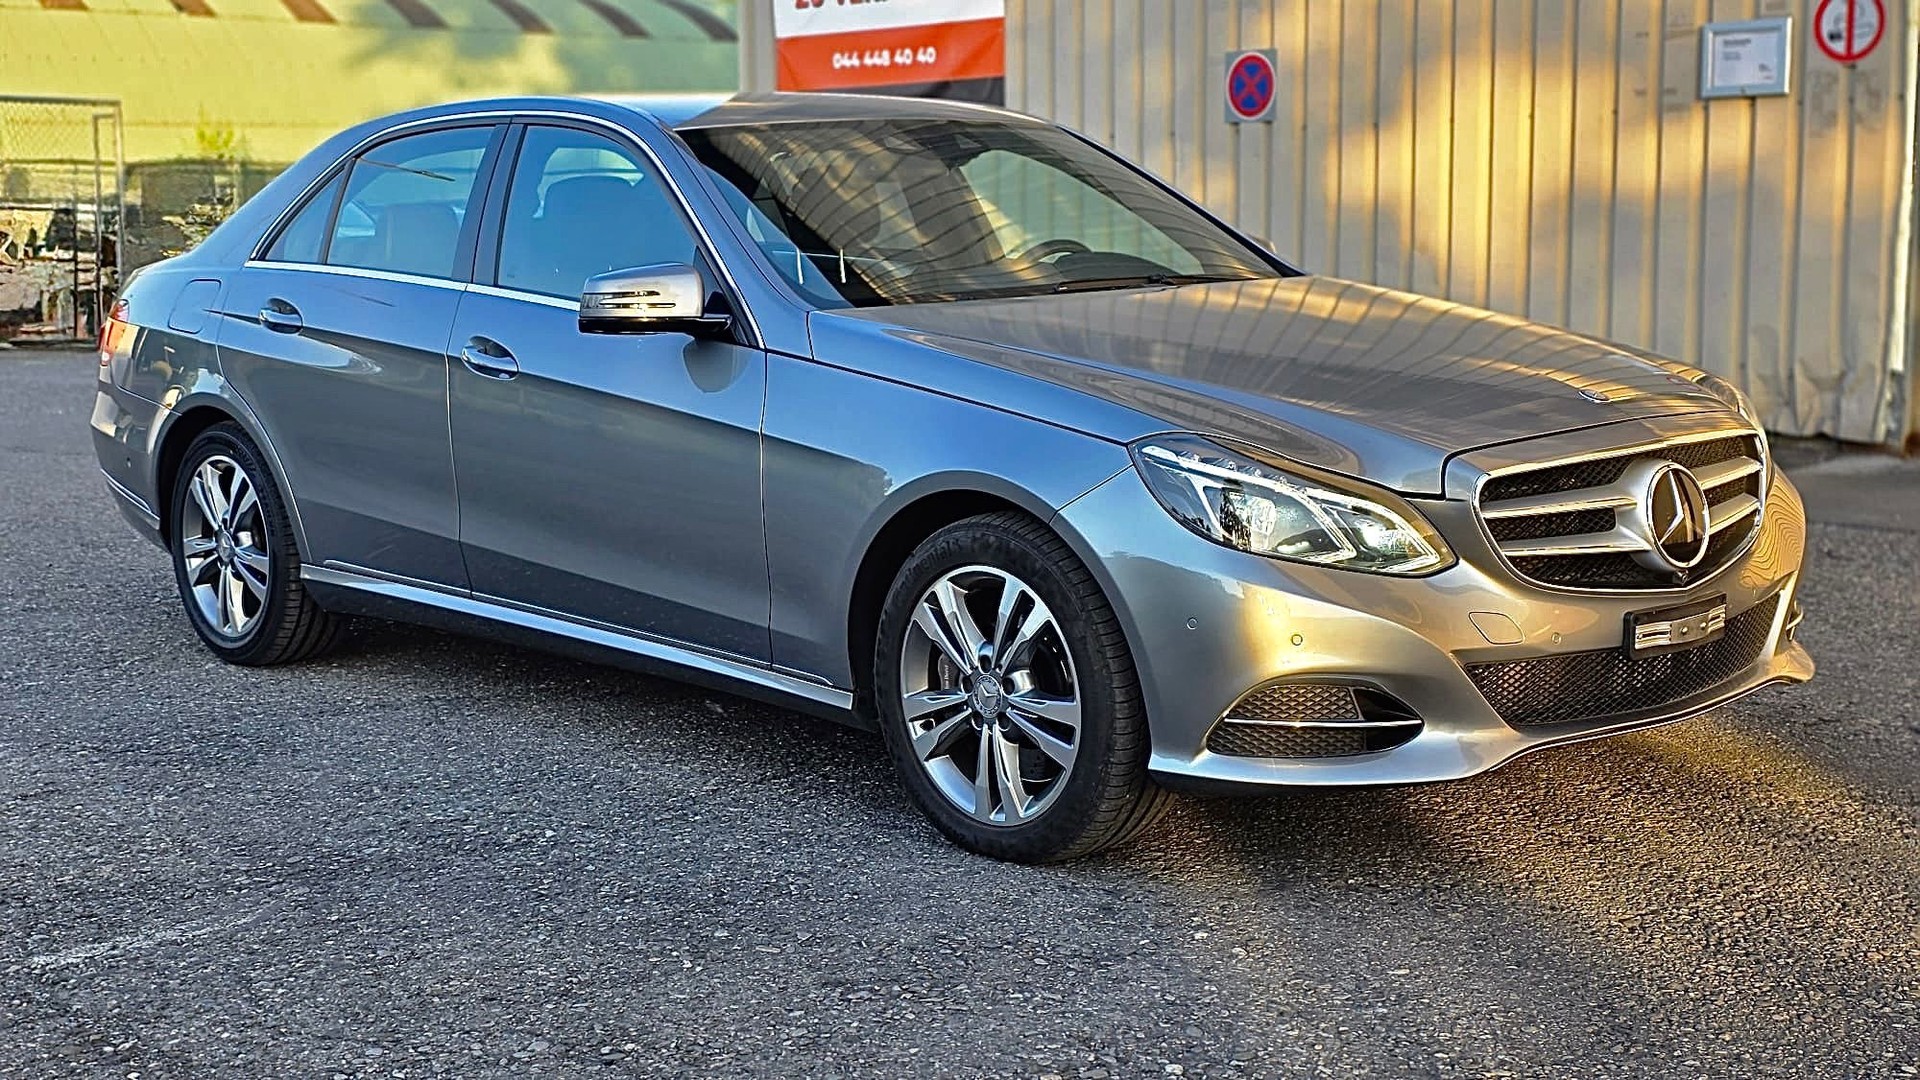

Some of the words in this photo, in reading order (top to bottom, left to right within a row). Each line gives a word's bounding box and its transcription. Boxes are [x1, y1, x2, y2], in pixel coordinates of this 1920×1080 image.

[832, 52, 860, 69] 044
[863, 49, 891, 67] 448
[894, 47, 913, 66] 40
[916, 46, 937, 65] 40
